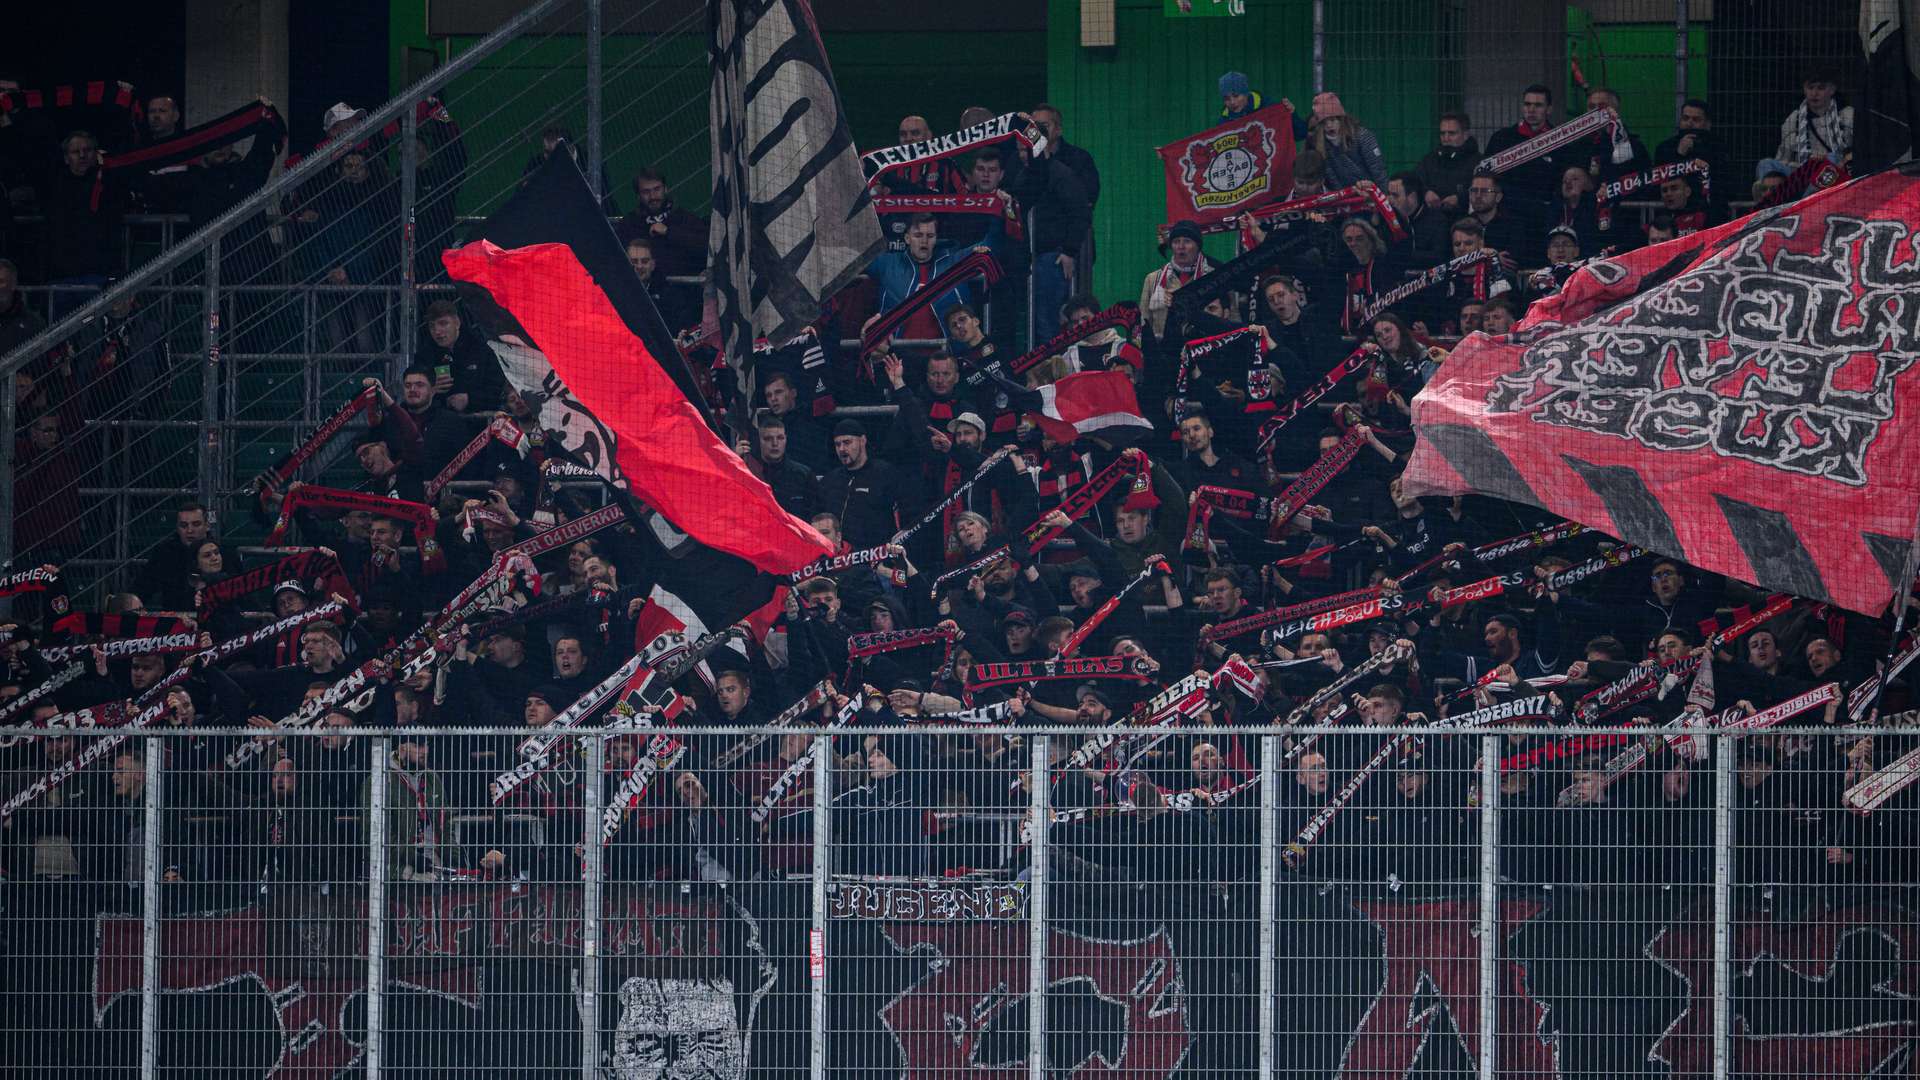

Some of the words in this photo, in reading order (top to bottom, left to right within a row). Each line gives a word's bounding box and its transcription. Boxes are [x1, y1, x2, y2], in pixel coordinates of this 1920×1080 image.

[871, 112, 1015, 170] LEVERKUSEN
[1606, 184, 1621, 199] ER
[1623, 177, 1642, 192] 04
[1287, 433, 1358, 497] EVERKUSEN
[522, 537, 544, 555] ER
[544, 530, 563, 549] 04
[564, 508, 620, 543] LEVERKU
[802, 562, 824, 578] 04
[825, 542, 888, 572] LEVERKU
